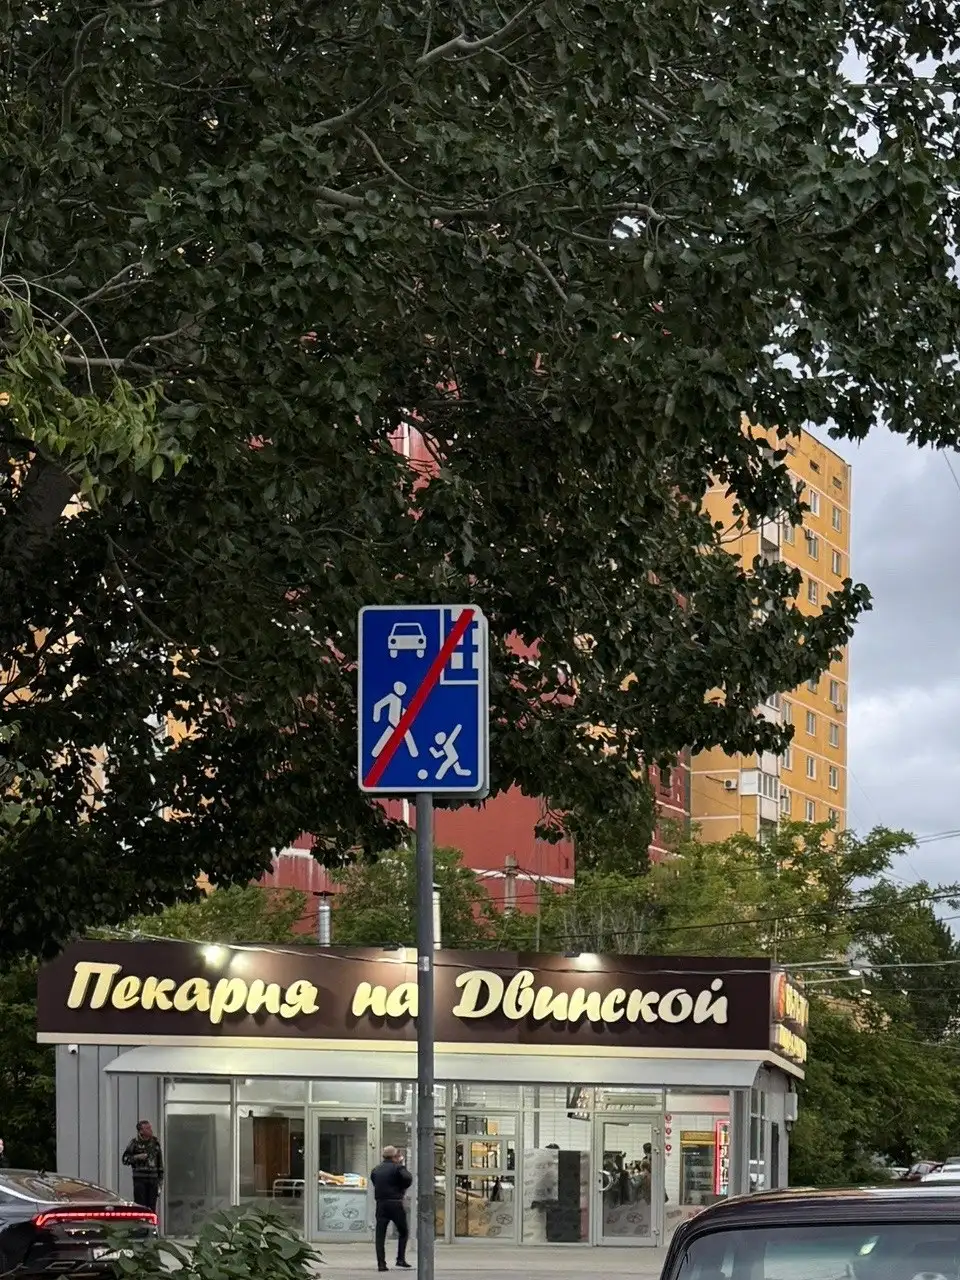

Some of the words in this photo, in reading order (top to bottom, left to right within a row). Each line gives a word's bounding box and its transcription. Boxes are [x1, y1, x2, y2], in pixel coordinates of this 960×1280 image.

[67, 961, 319, 1024] Пекарня
[352, 982, 418, 1018] на
[452, 970, 729, 1025] Двинской
